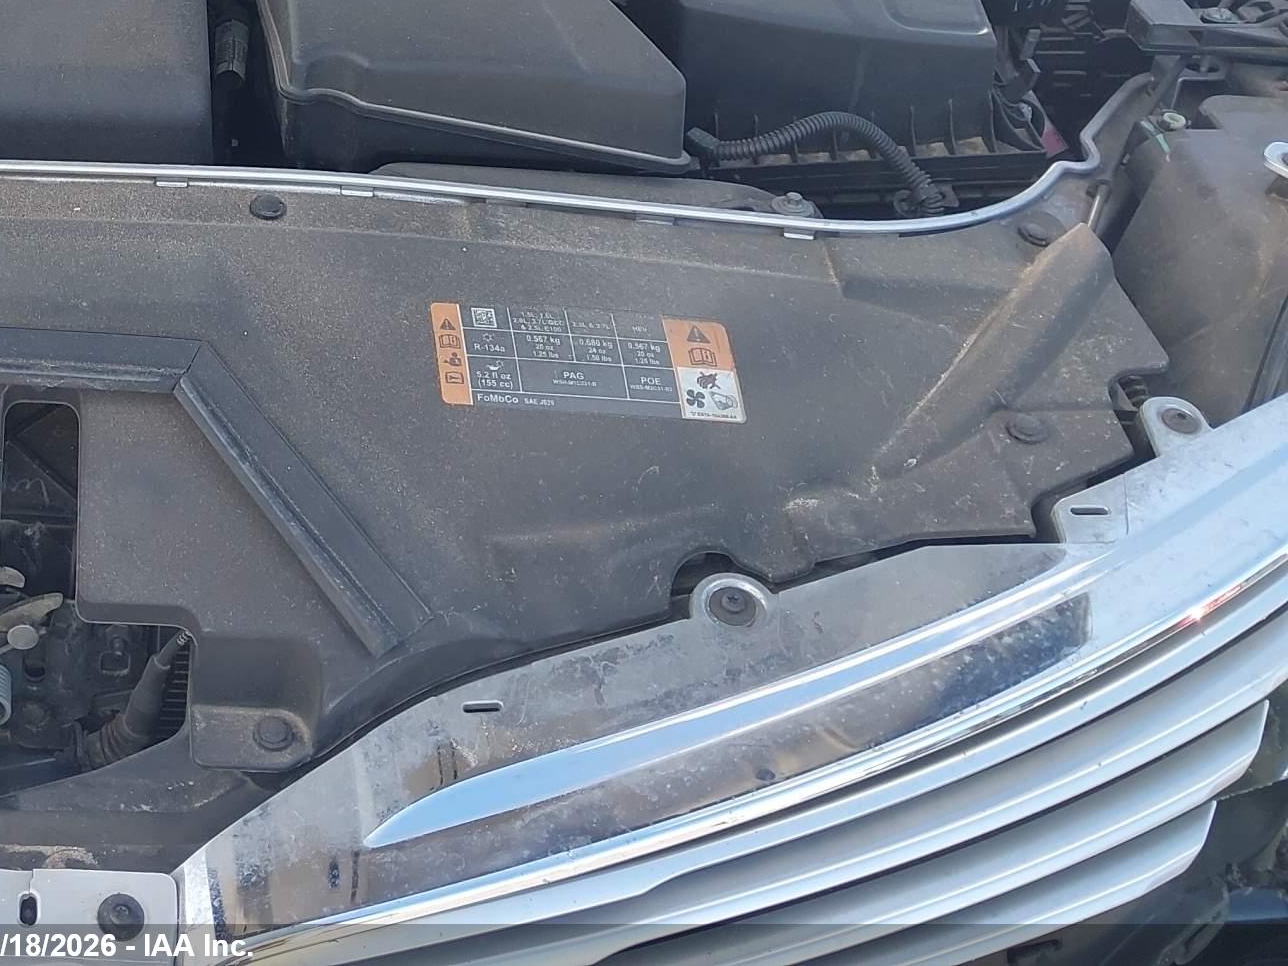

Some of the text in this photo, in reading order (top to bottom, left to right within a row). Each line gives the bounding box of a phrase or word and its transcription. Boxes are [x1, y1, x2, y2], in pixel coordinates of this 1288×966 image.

[550, 336, 561, 346] kg
[602, 339, 613, 349] kg
[474, 343, 506, 352] R-134a
[650, 344, 661, 353] kg
[563, 371, 585, 380] PAG
[478, 379, 513, 389] (155 cc)
[640, 376, 662, 385] POE
[477, 394, 519, 404] FoMoCo
[524, 397, 539, 405] SAE
